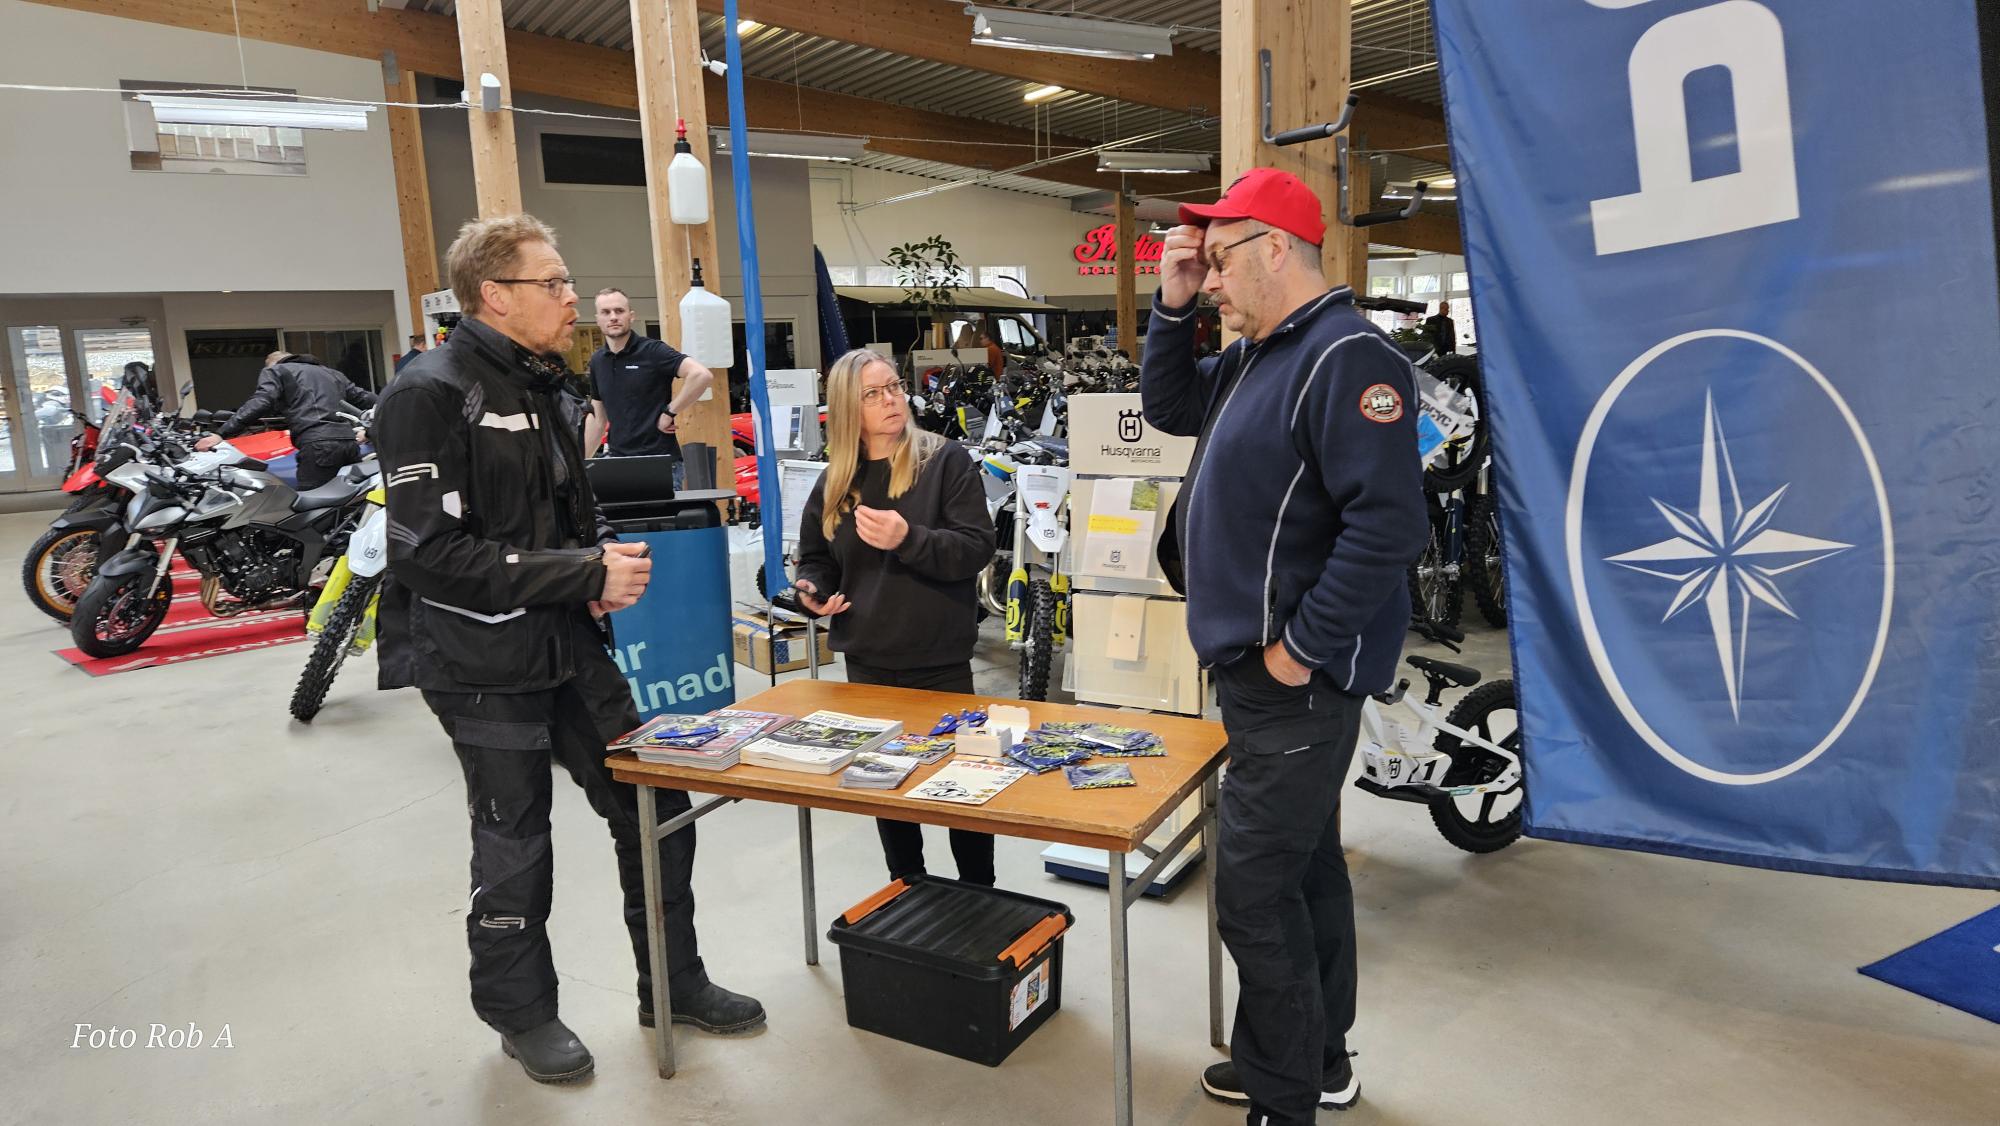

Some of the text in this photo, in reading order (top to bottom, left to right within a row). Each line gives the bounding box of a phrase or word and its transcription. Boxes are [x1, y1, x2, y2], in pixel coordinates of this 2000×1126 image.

[1101, 445, 1161, 458] Husqvarna
[163, 635, 306, 662] HOND
[1423, 759, 1438, 781] 1
